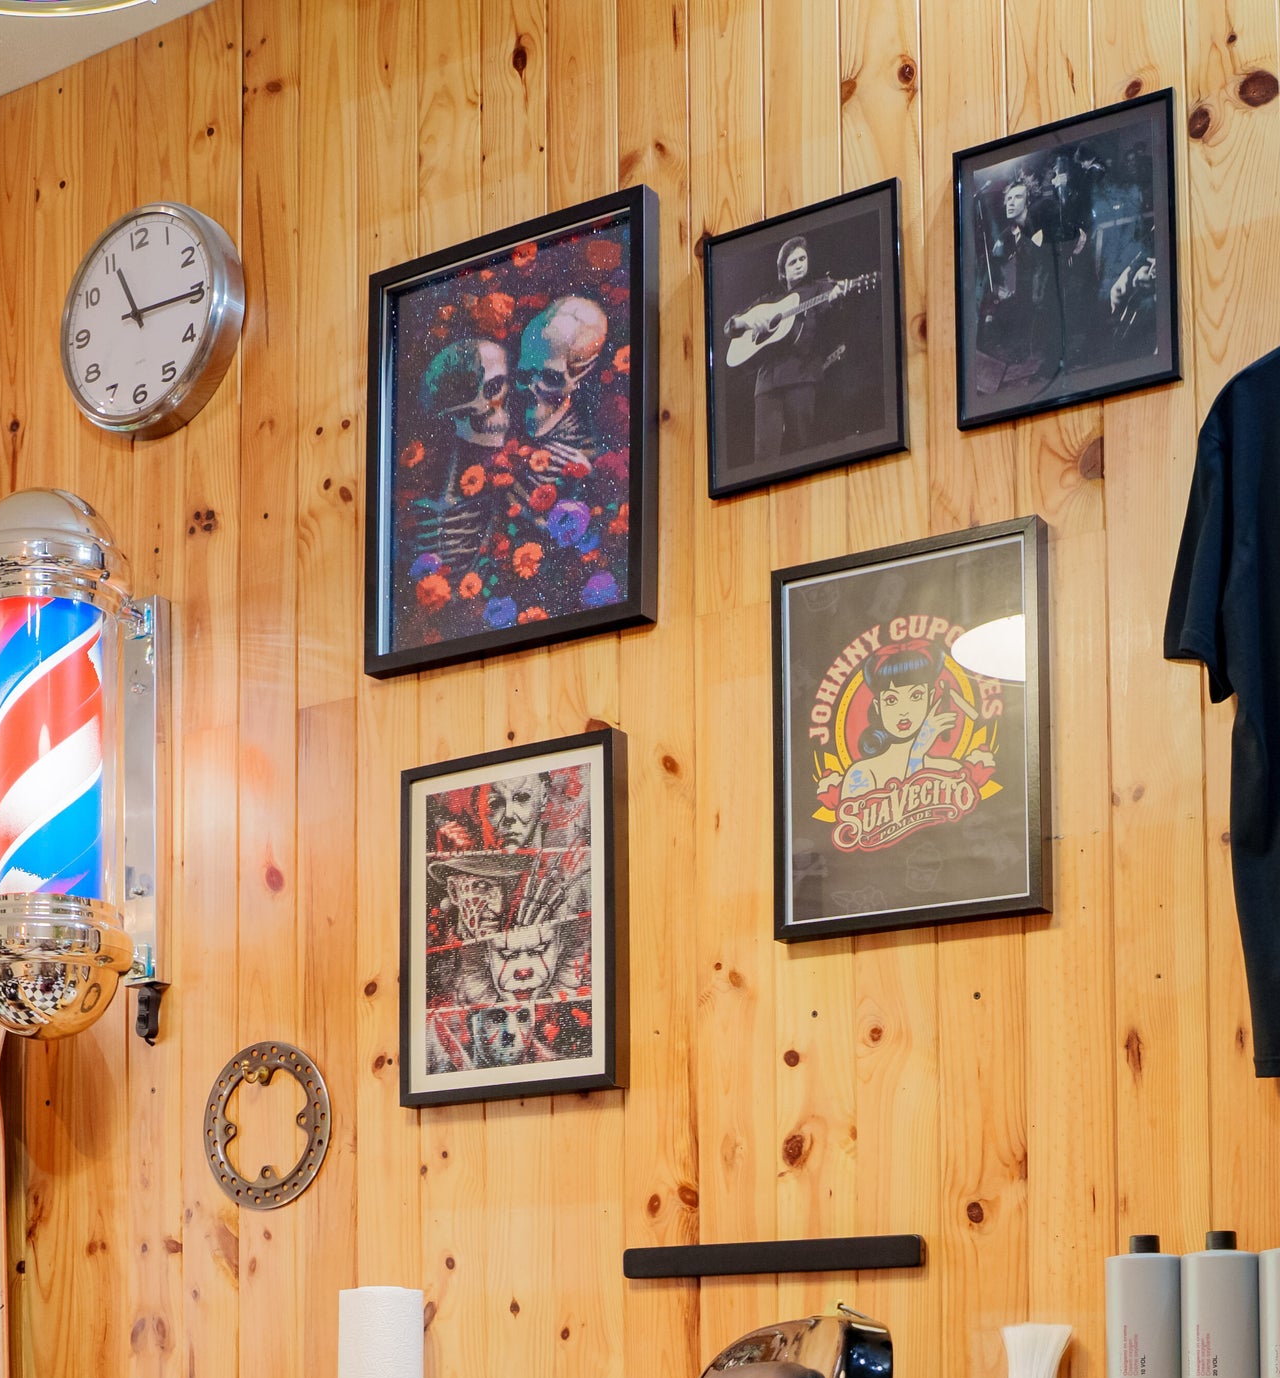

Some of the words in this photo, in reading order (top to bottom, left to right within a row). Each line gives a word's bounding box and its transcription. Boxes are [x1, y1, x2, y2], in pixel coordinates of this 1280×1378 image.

[129, 227, 149, 252] 12
[164, 226, 170, 246] 1
[104, 253, 117, 275] 11
[180, 246, 196, 269] 2
[84, 287, 101, 309] 10
[189, 281, 205, 305] 3
[74, 329, 91, 350] 9
[181, 322, 197, 343] 4
[84, 362, 101, 383] 8
[161, 360, 177, 383] 5
[105, 383, 119, 404] 7
[132, 383, 148, 405] 6
[809, 624, 882, 745] JOHNNY
[879, 809, 933, 839] POMADE
